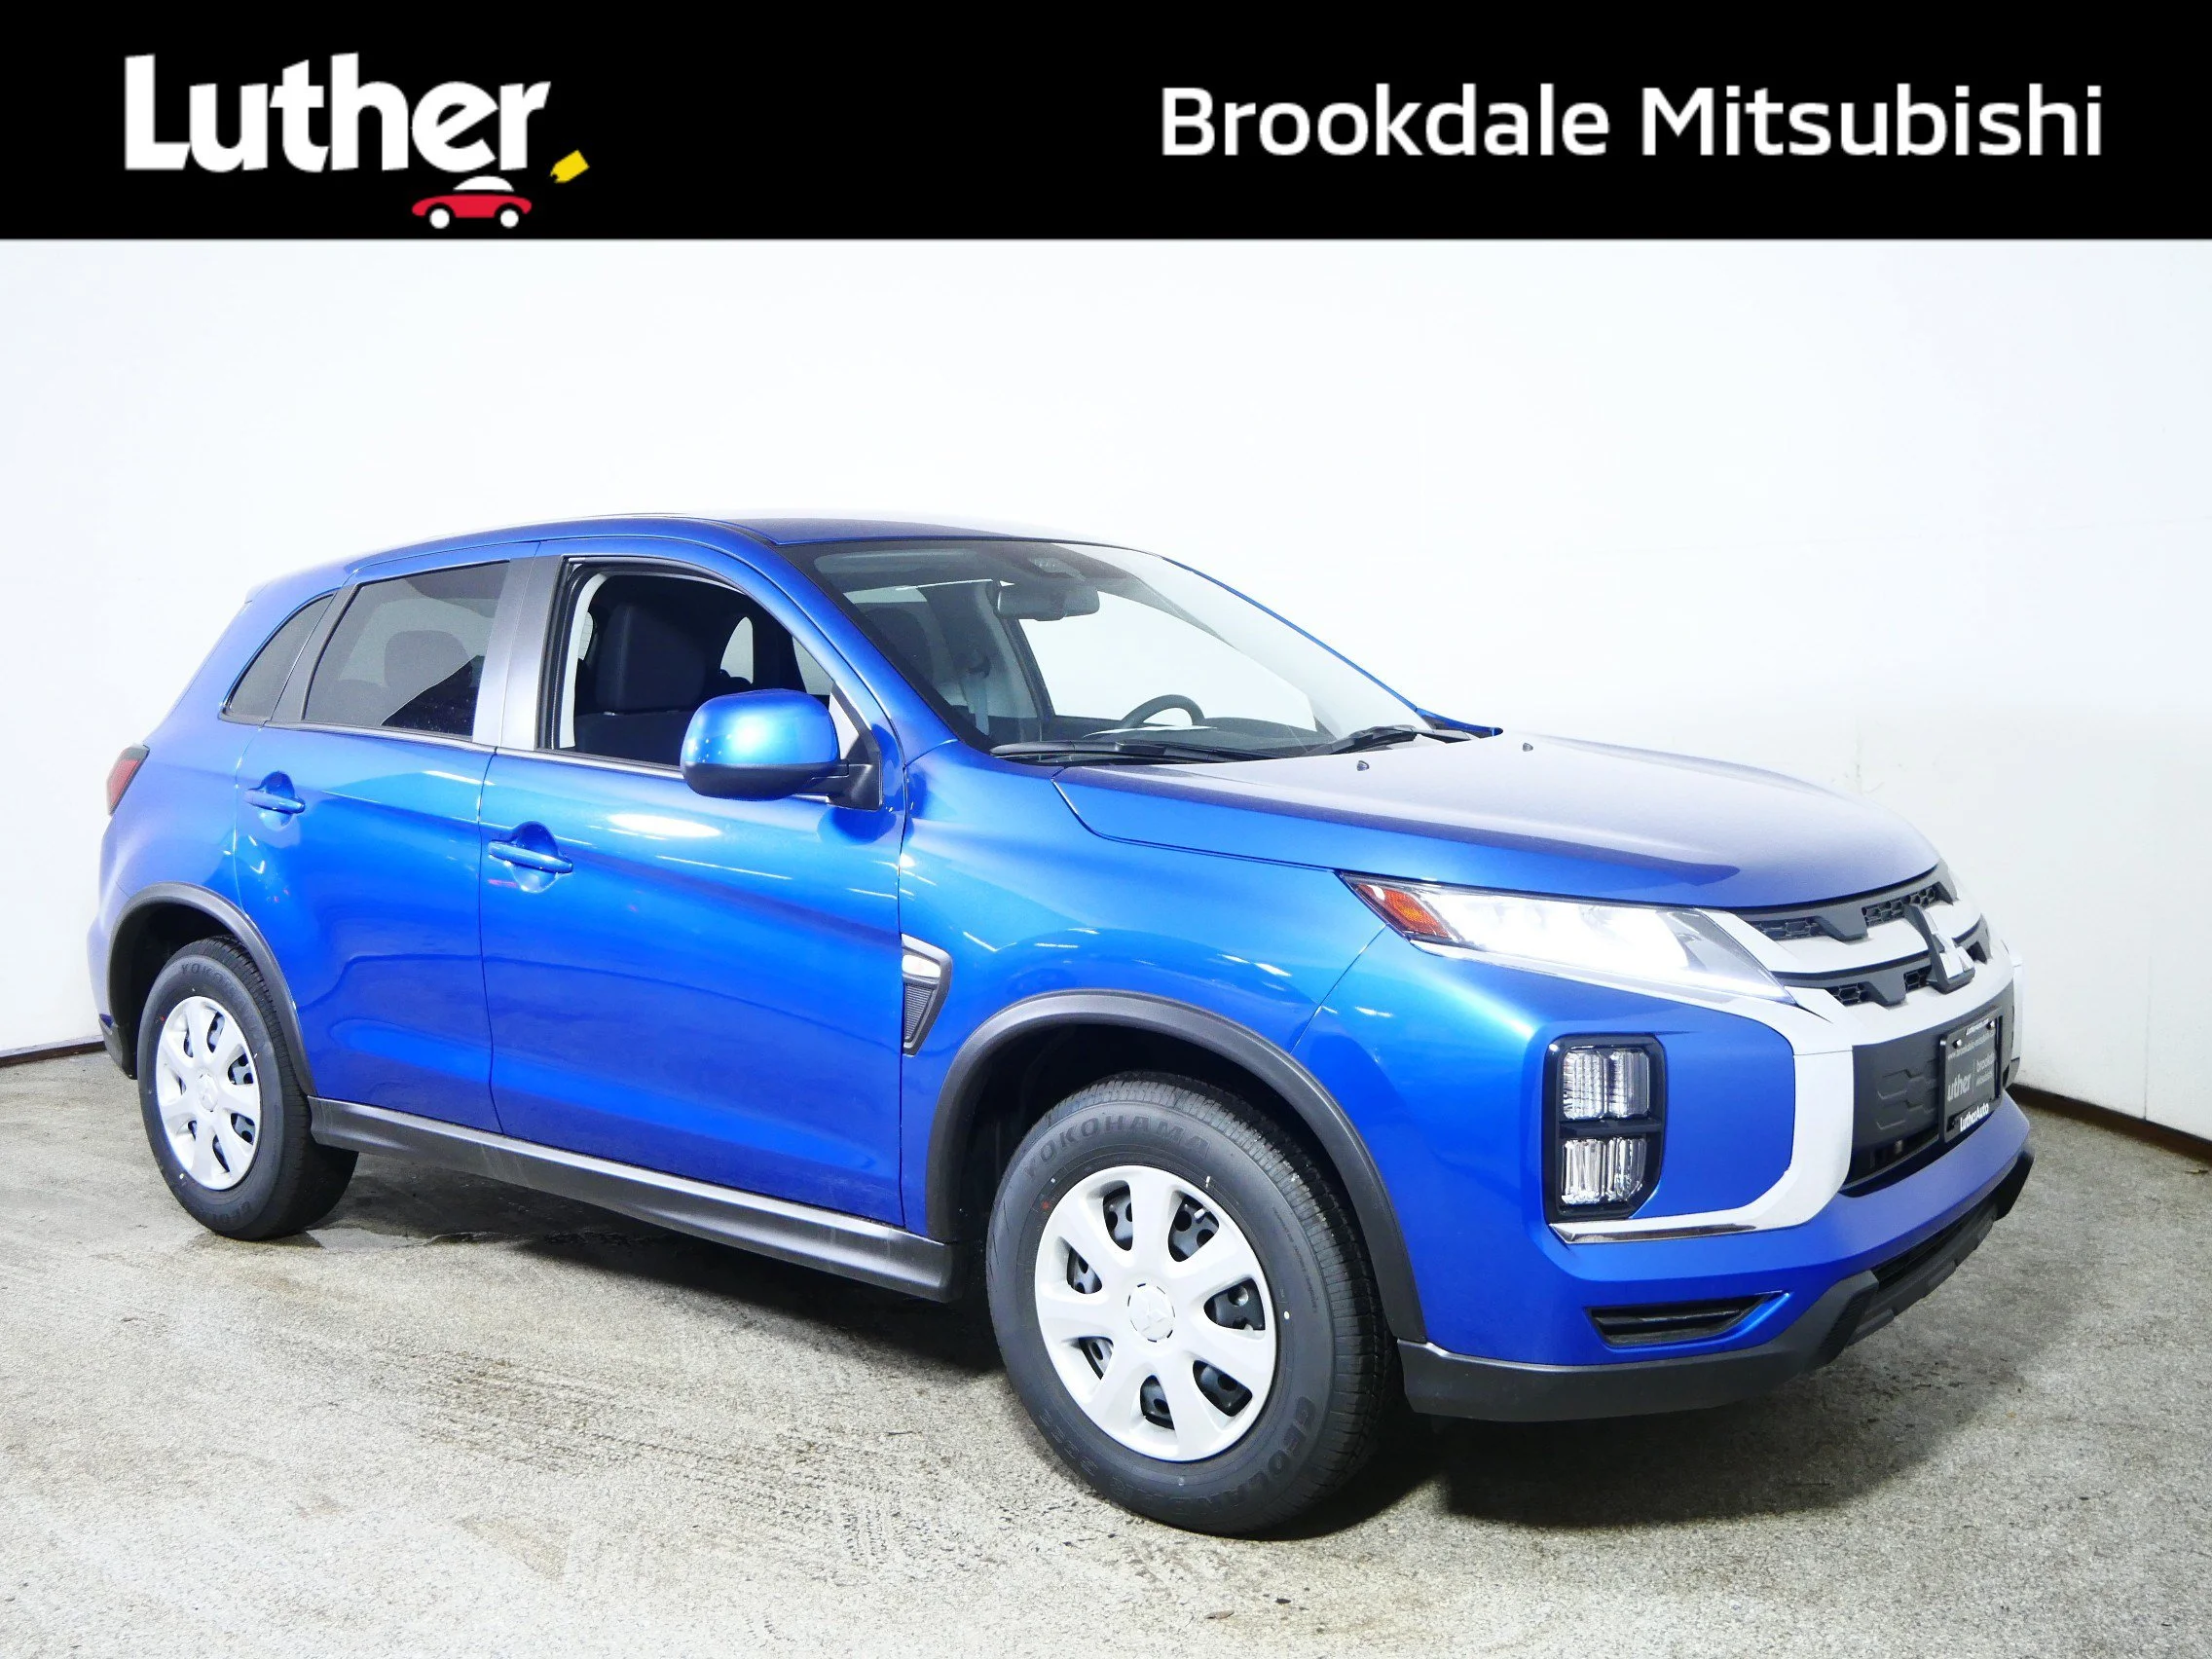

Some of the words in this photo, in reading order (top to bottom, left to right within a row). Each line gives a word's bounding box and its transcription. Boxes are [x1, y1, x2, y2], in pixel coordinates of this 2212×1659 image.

[1946, 1073, 1972, 1102] uther
[1960, 1102, 1990, 1132] LutherAuto
[1023, 1115, 1211, 1180] YOKOHAMA
